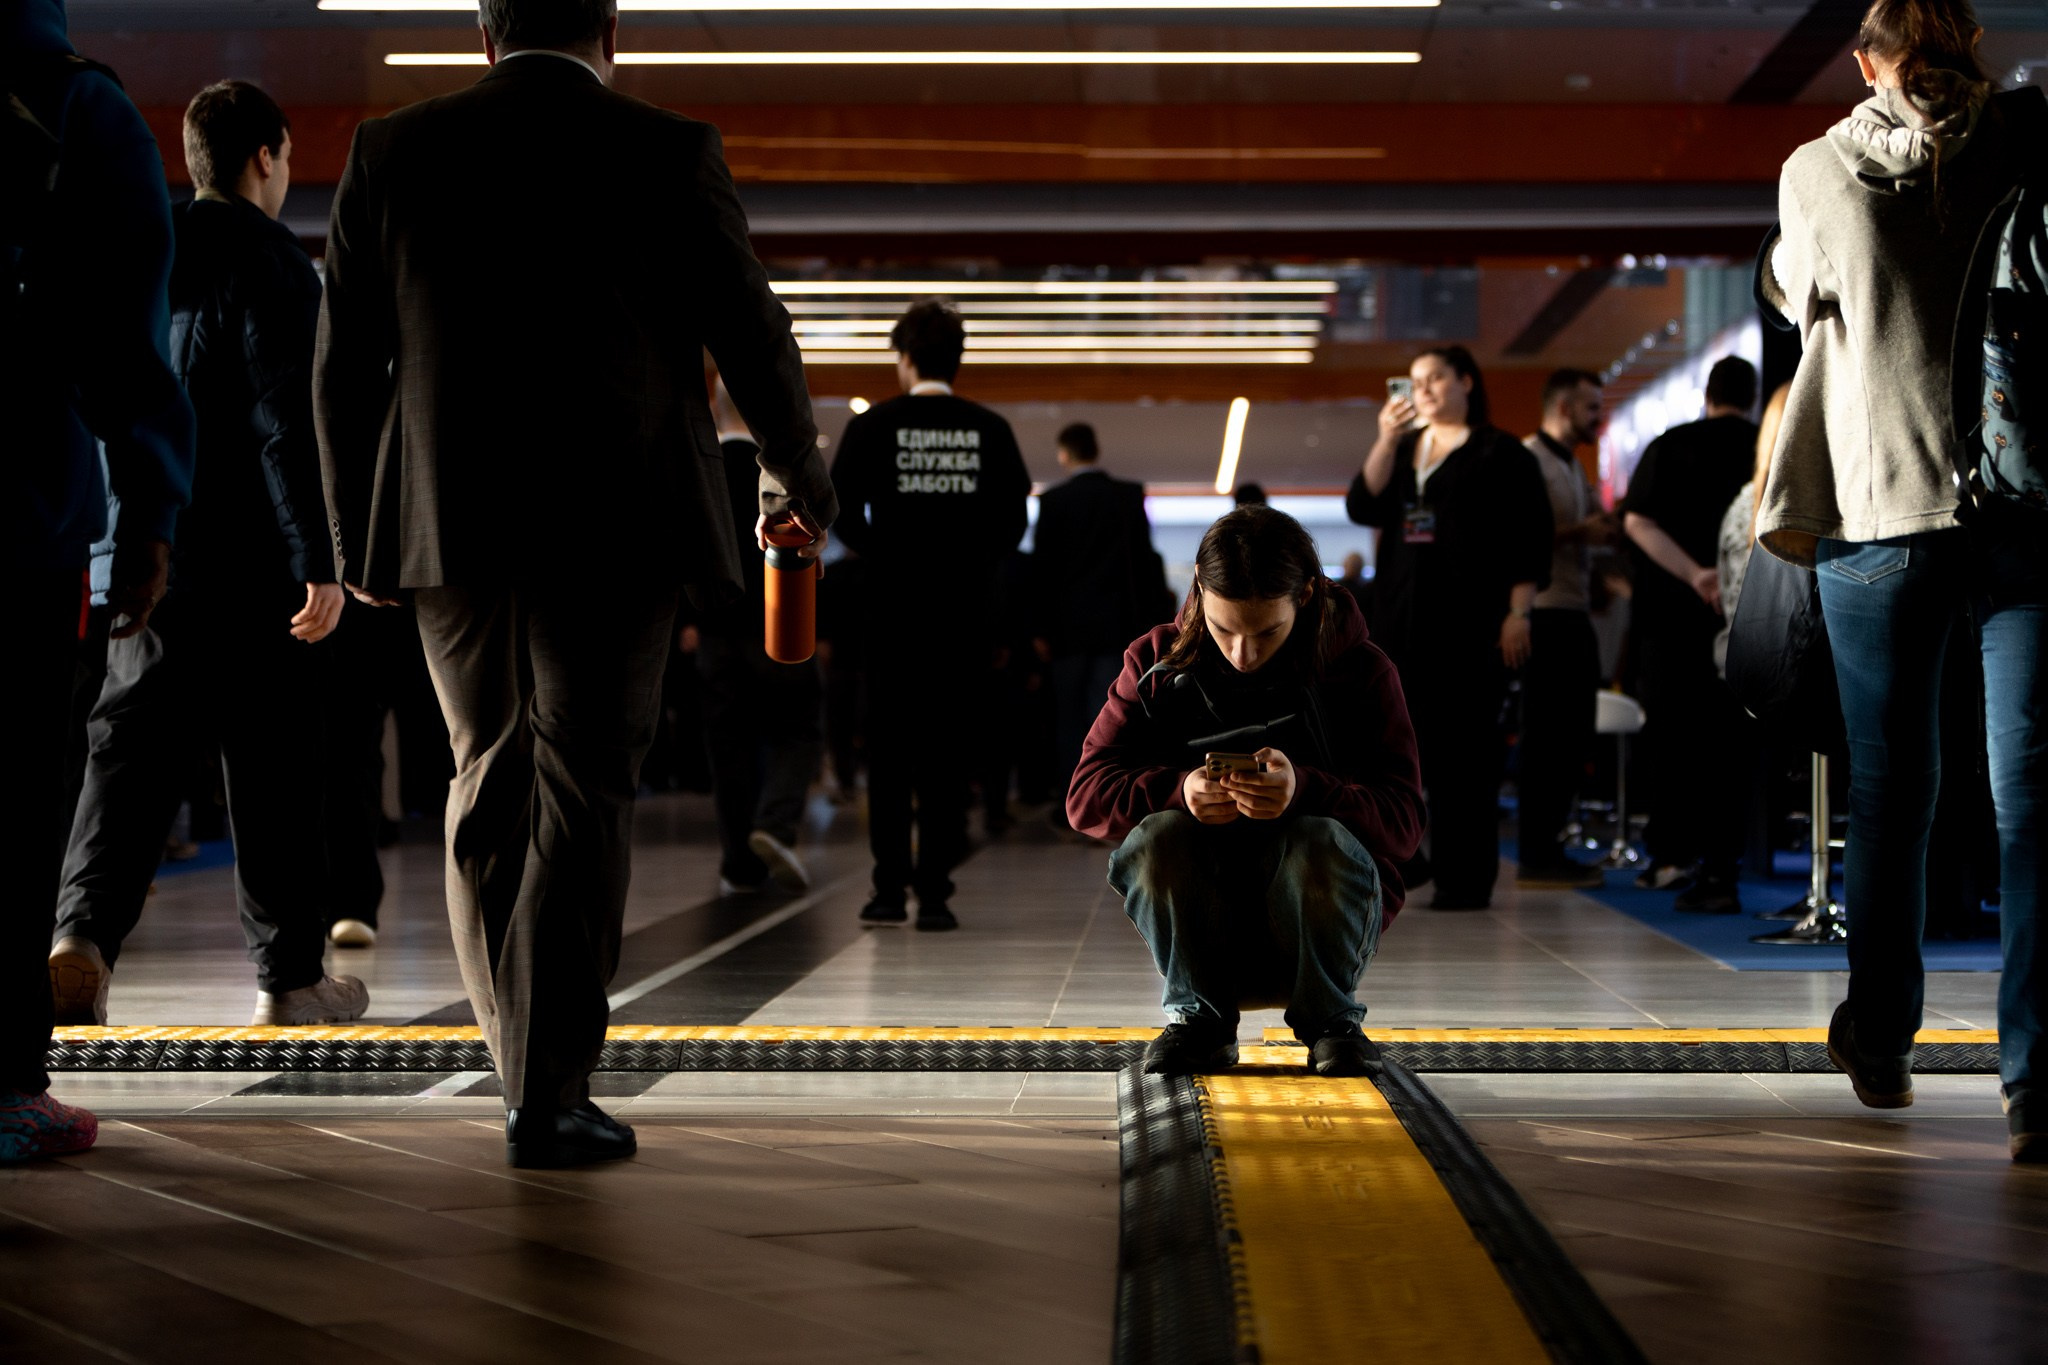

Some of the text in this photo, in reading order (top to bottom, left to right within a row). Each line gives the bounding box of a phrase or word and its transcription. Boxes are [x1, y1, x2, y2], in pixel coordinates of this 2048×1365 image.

[897, 428, 980, 449] ЕДИНАЯ
[896, 451, 980, 470] СЛУЖБА
[897, 473, 978, 493] ЗАБОТЫ
